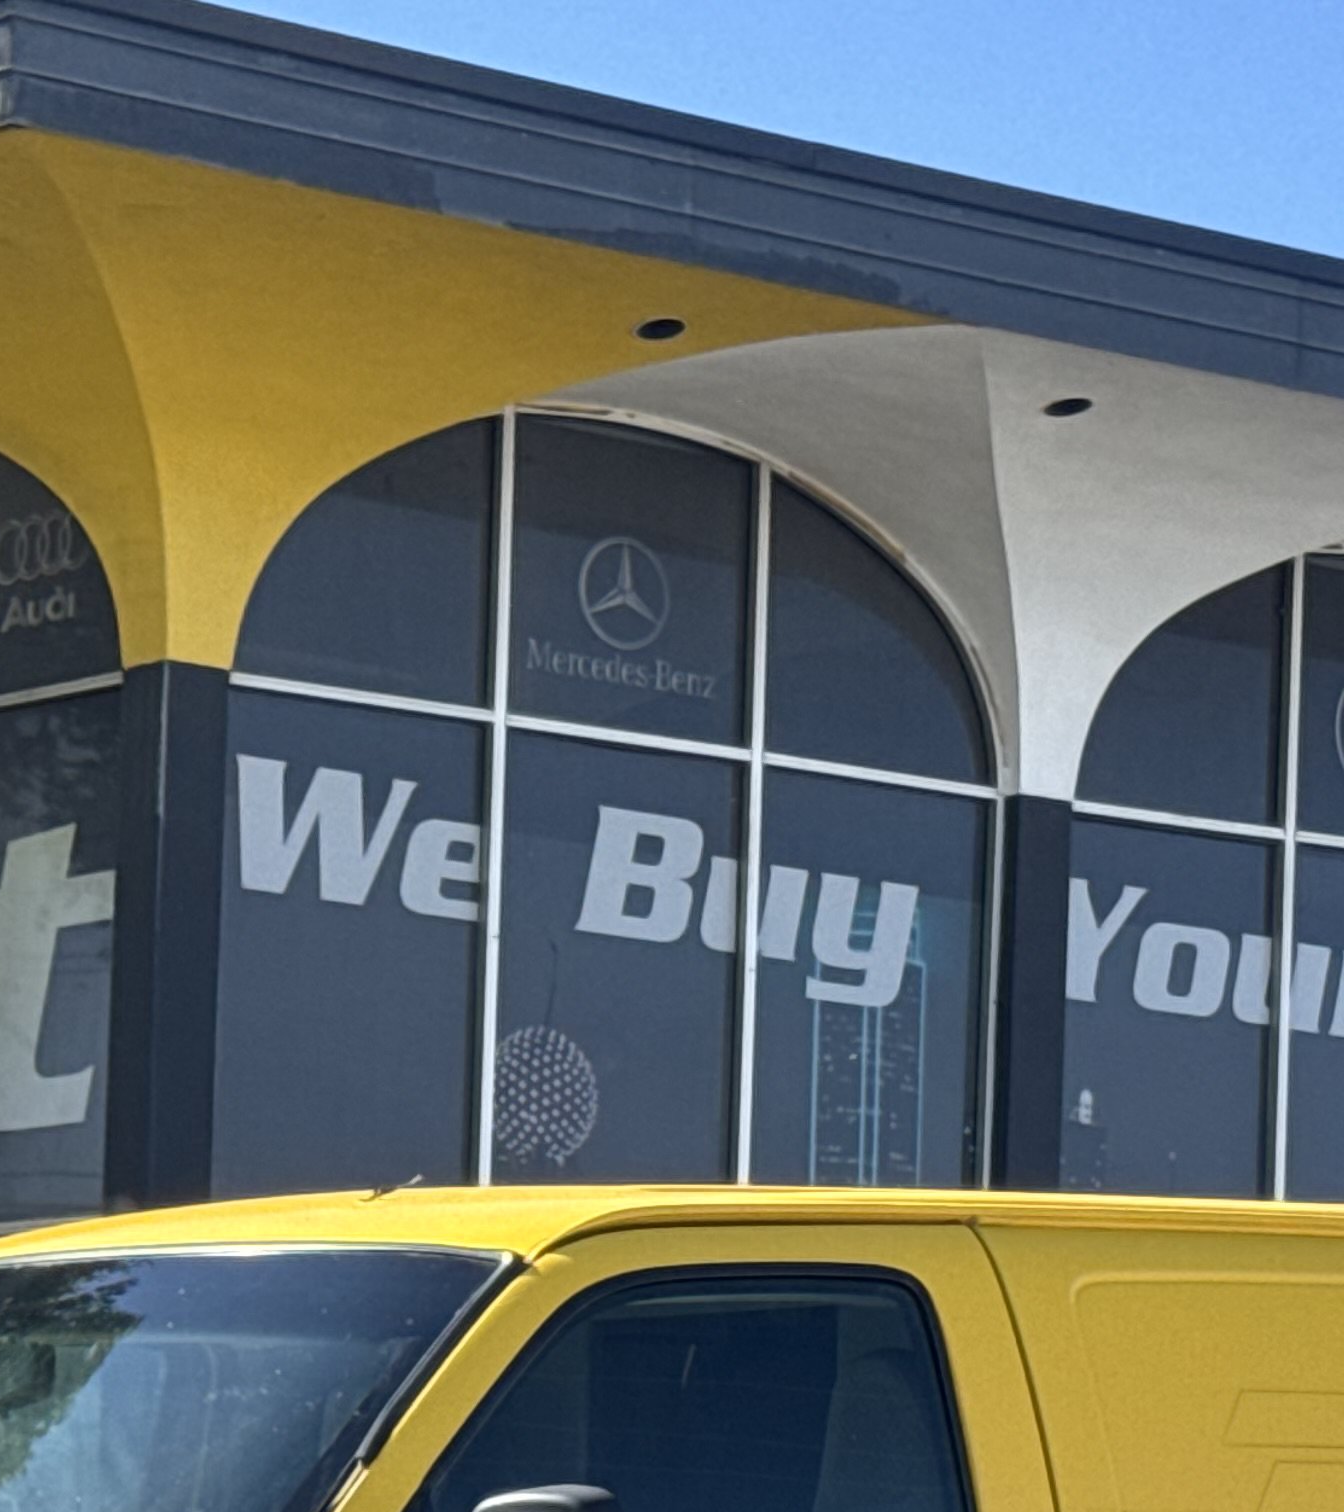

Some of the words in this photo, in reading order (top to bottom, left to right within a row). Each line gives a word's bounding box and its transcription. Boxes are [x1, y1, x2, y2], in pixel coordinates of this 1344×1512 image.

[526, 637, 716, 700] Mercedes-Benz
[235, 753, 481, 921] We
[574, 805, 919, 1007] Buy
